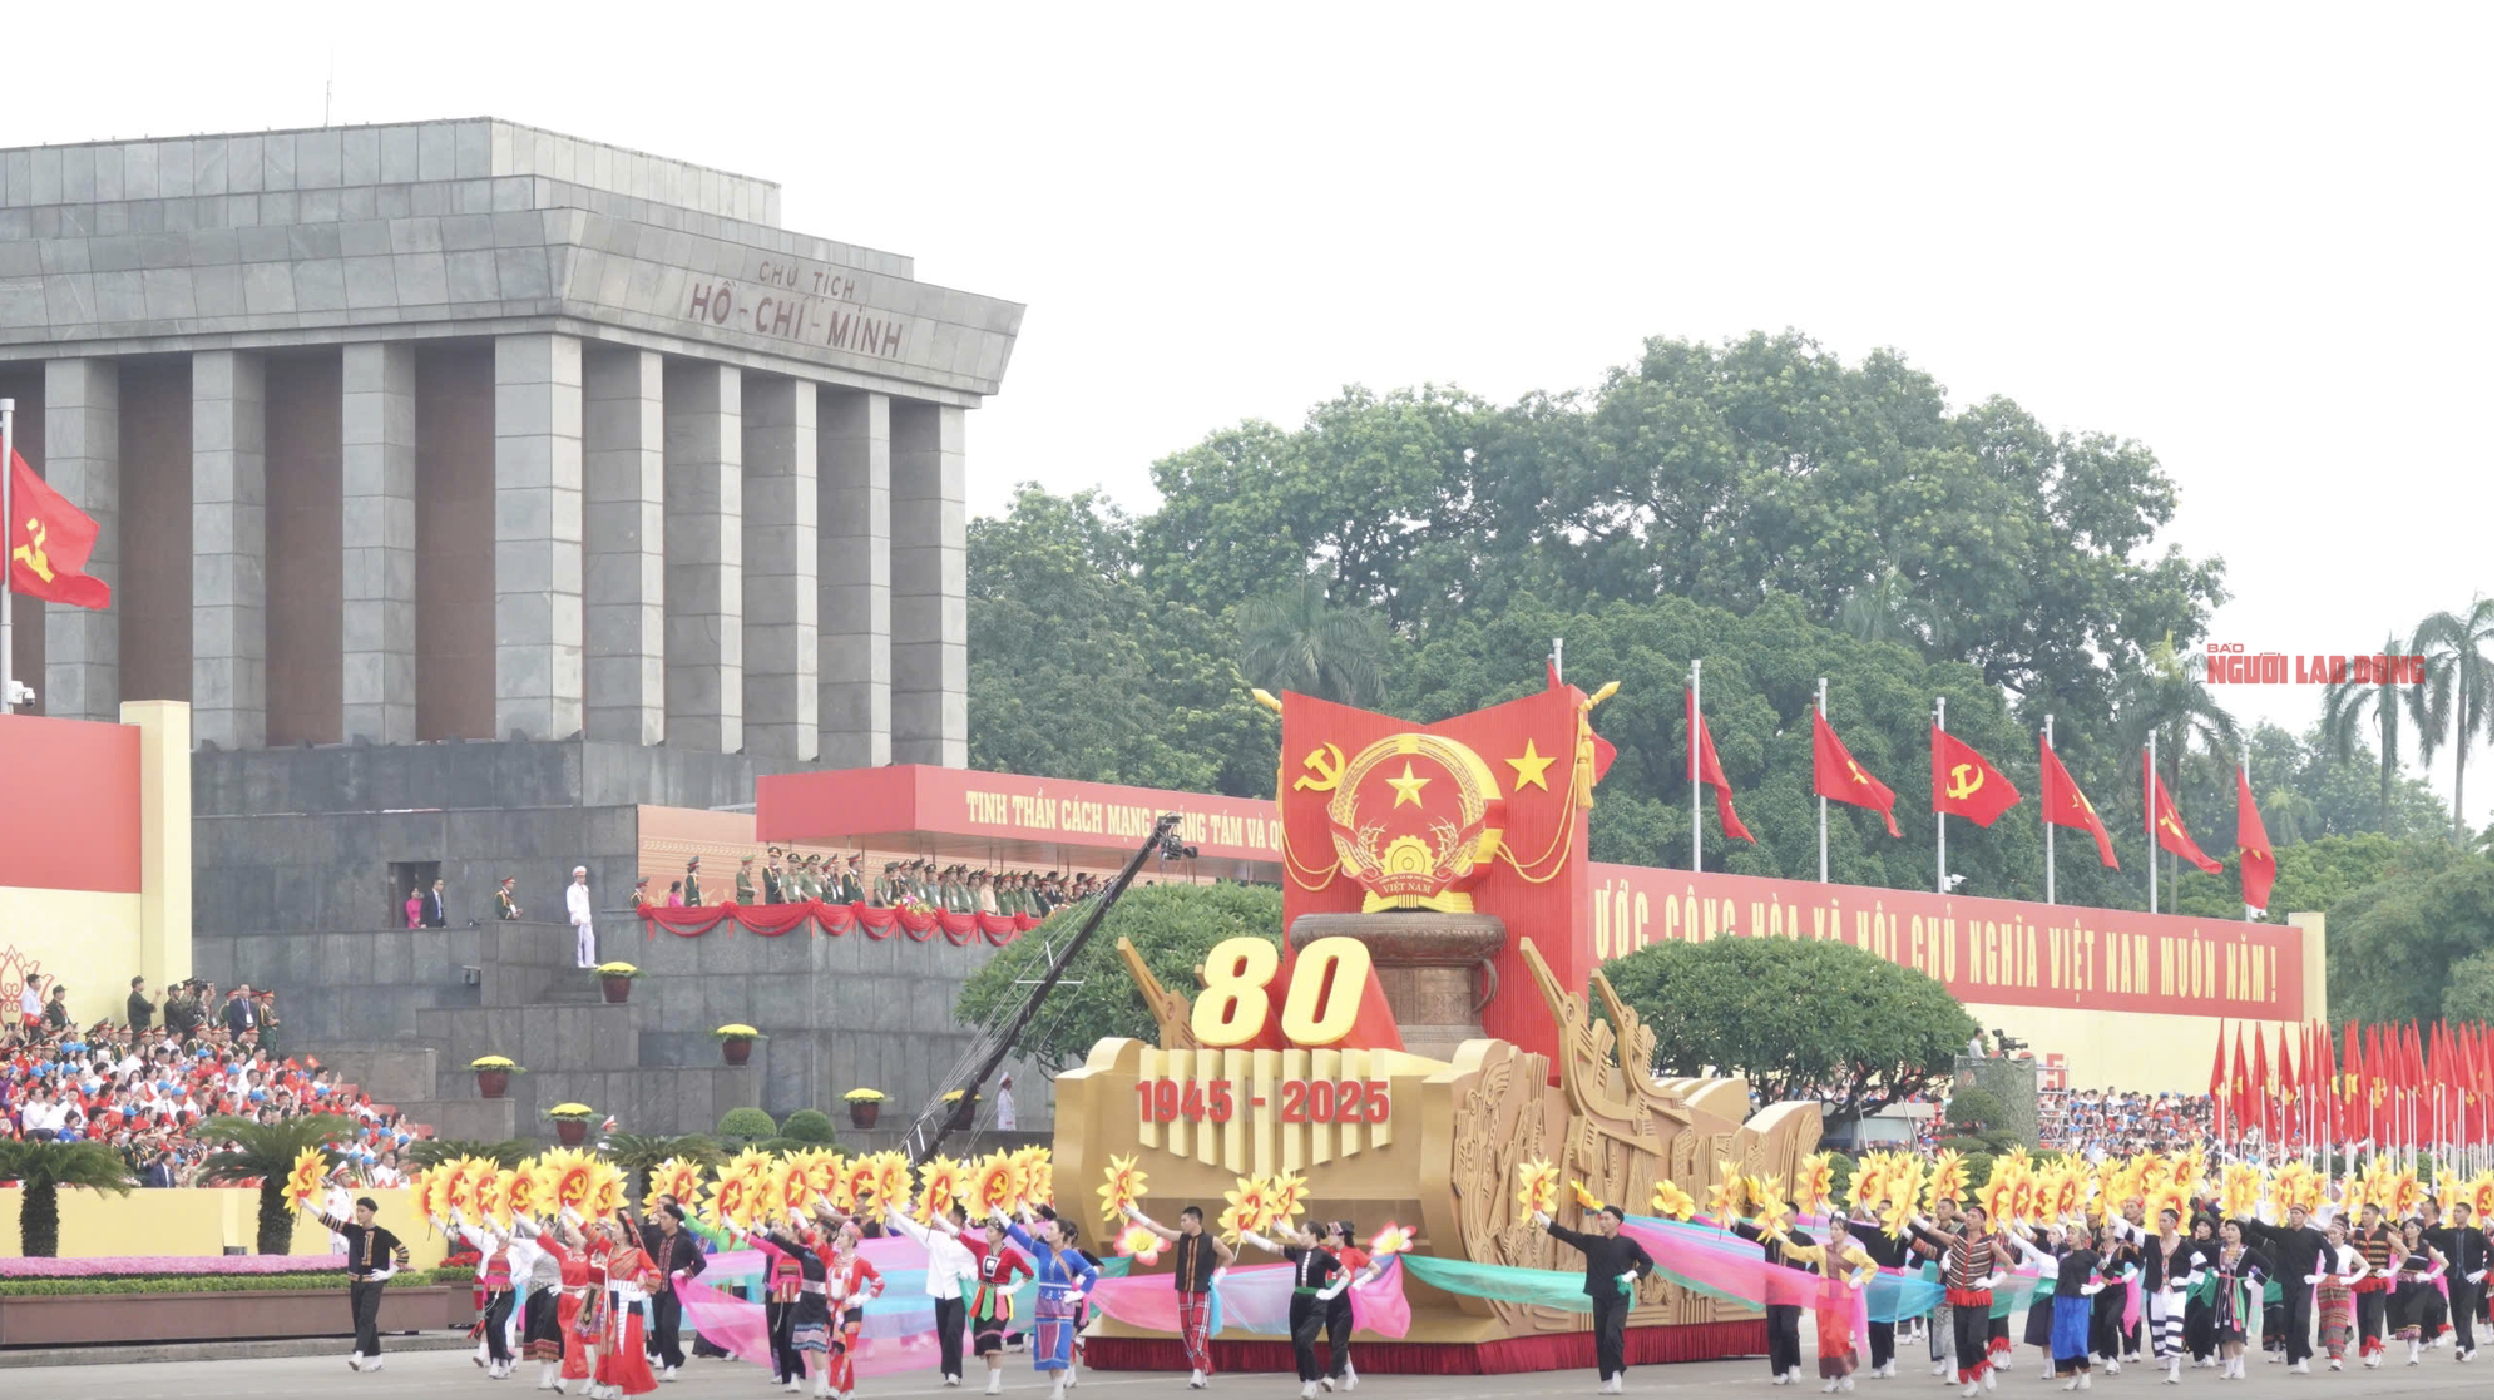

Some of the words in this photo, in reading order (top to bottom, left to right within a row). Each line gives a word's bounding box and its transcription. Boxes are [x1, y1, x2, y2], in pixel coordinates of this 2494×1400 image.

[965, 789, 1009, 826] TINH
[1061, 794, 1104, 835] CÁCH
[1106, 804, 1150, 844] MẠNG
[1210, 809, 1243, 847] TÁM
[1246, 811, 1267, 849] VÀ
[1191, 937, 1371, 1045] 80
[1968, 913, 2038, 988] NGHĨA
[2048, 918, 2095, 1003] VIỆT
[2105, 931, 2150, 994] NAM
[2160, 927, 2216, 999] MUÔN
[1135, 1078, 1234, 1124] 1945
[1281, 1079, 1390, 1124] 2025
